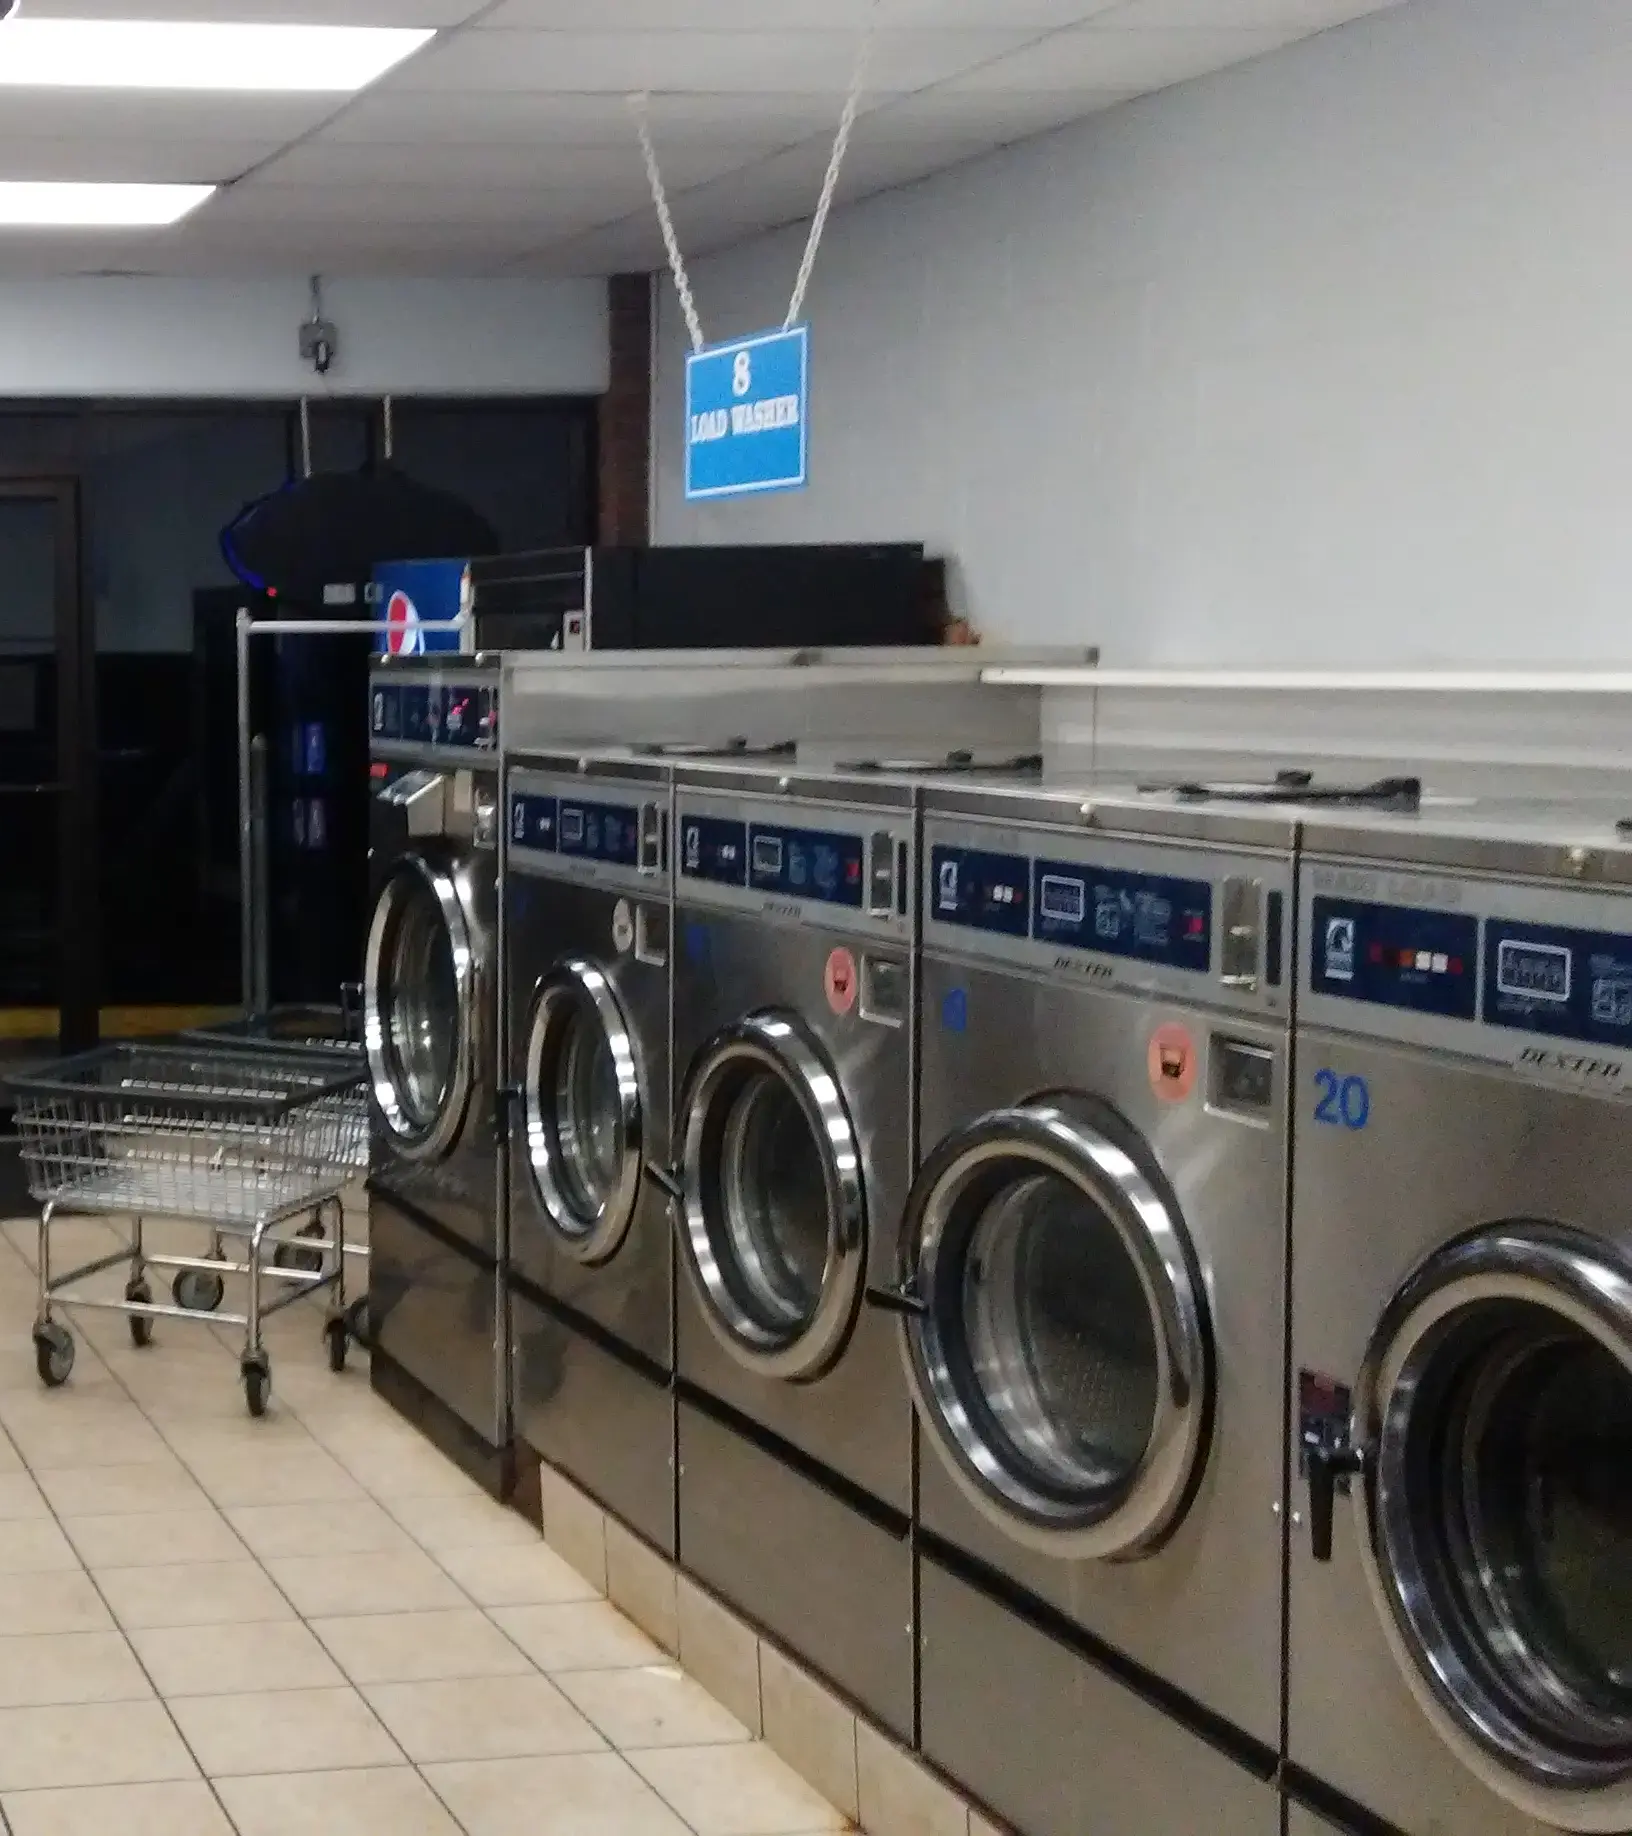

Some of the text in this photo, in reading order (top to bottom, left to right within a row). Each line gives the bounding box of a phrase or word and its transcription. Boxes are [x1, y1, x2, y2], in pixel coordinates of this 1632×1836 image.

[732, 351, 751, 396] 8
[690, 394, 799, 444] LOAD WASHER
[1519, 1046, 1623, 1077] DEXTER
[1313, 1068, 1369, 1131] 20
